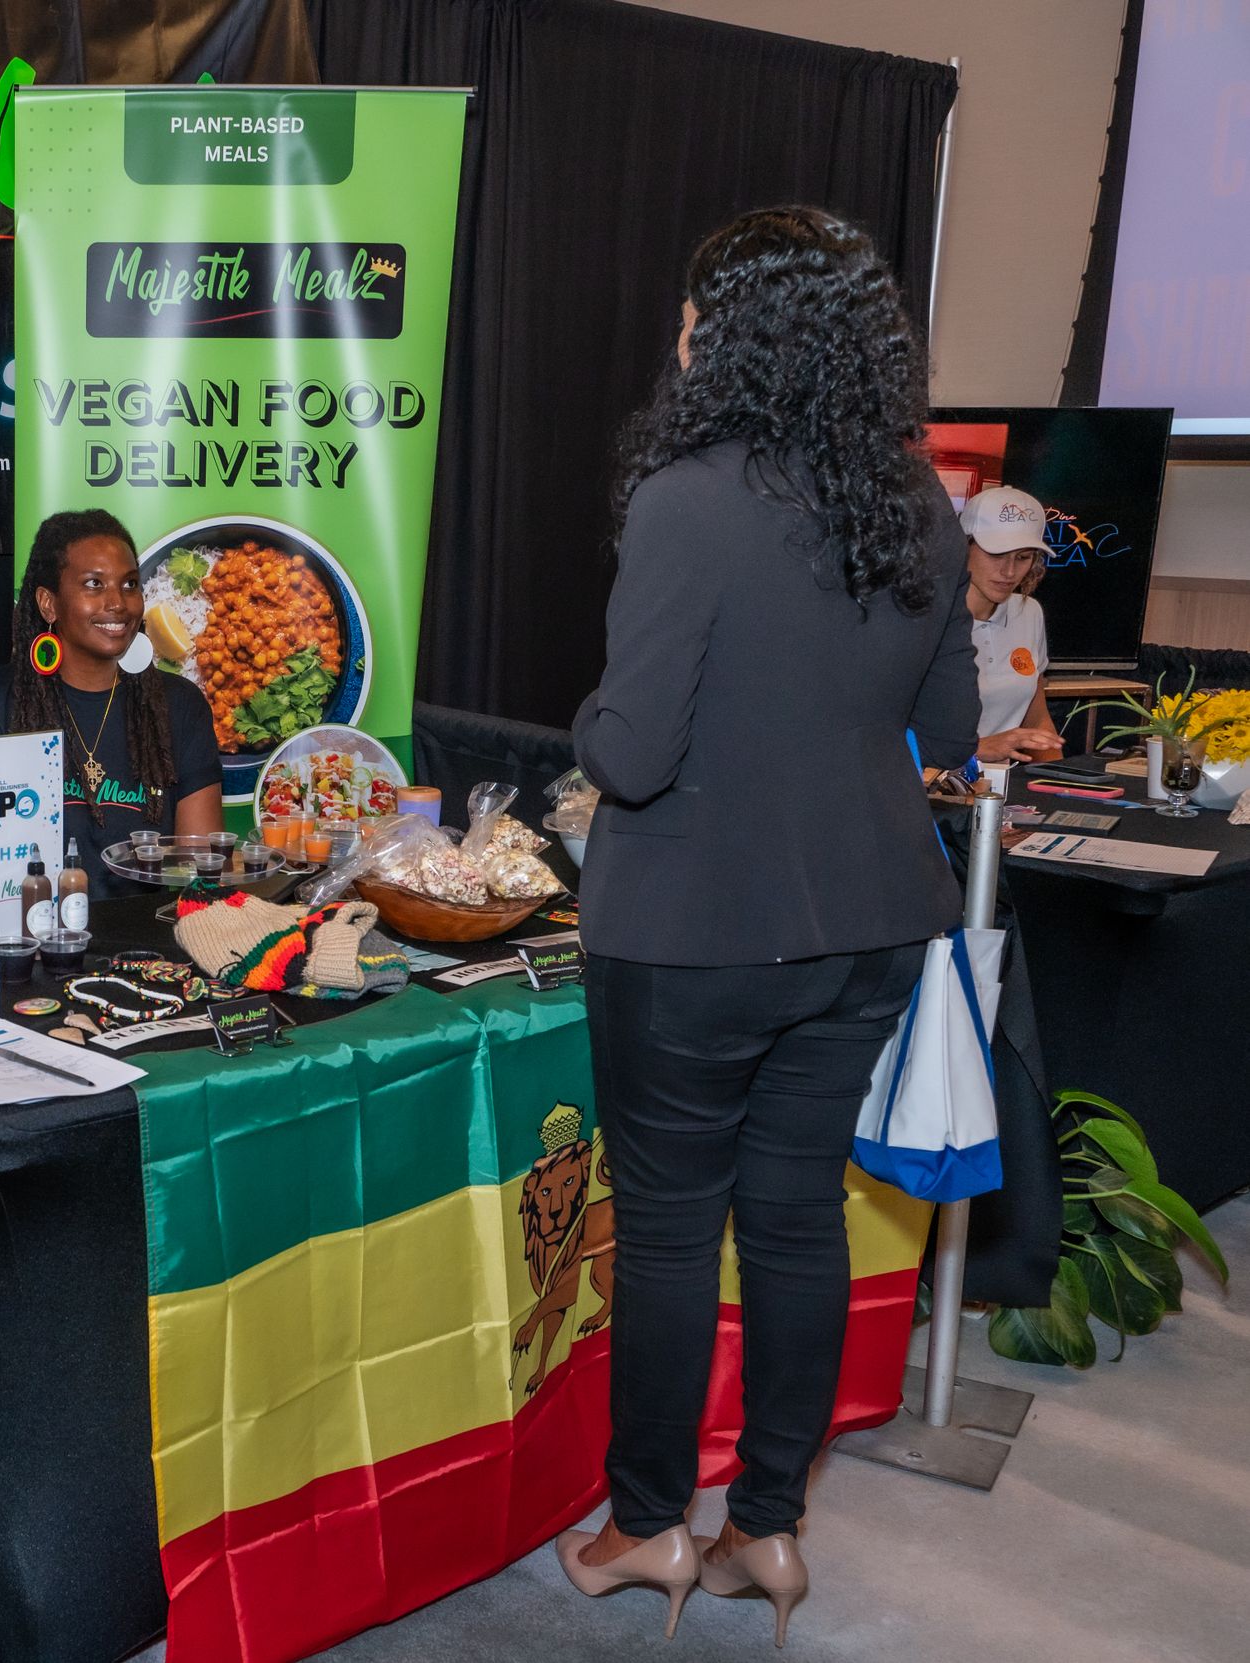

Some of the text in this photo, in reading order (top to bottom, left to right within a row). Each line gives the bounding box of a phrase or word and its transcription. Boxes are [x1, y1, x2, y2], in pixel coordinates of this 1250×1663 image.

[170, 116, 305, 135] PLANT-BASED
[204, 145, 269, 163] MEALS
[105, 247, 386, 316] Majestik Mealz
[33, 378, 425, 429] VEGAN FOOD
[84, 440, 359, 490] DELIVERY
[1045, 544, 1087, 568] EA
